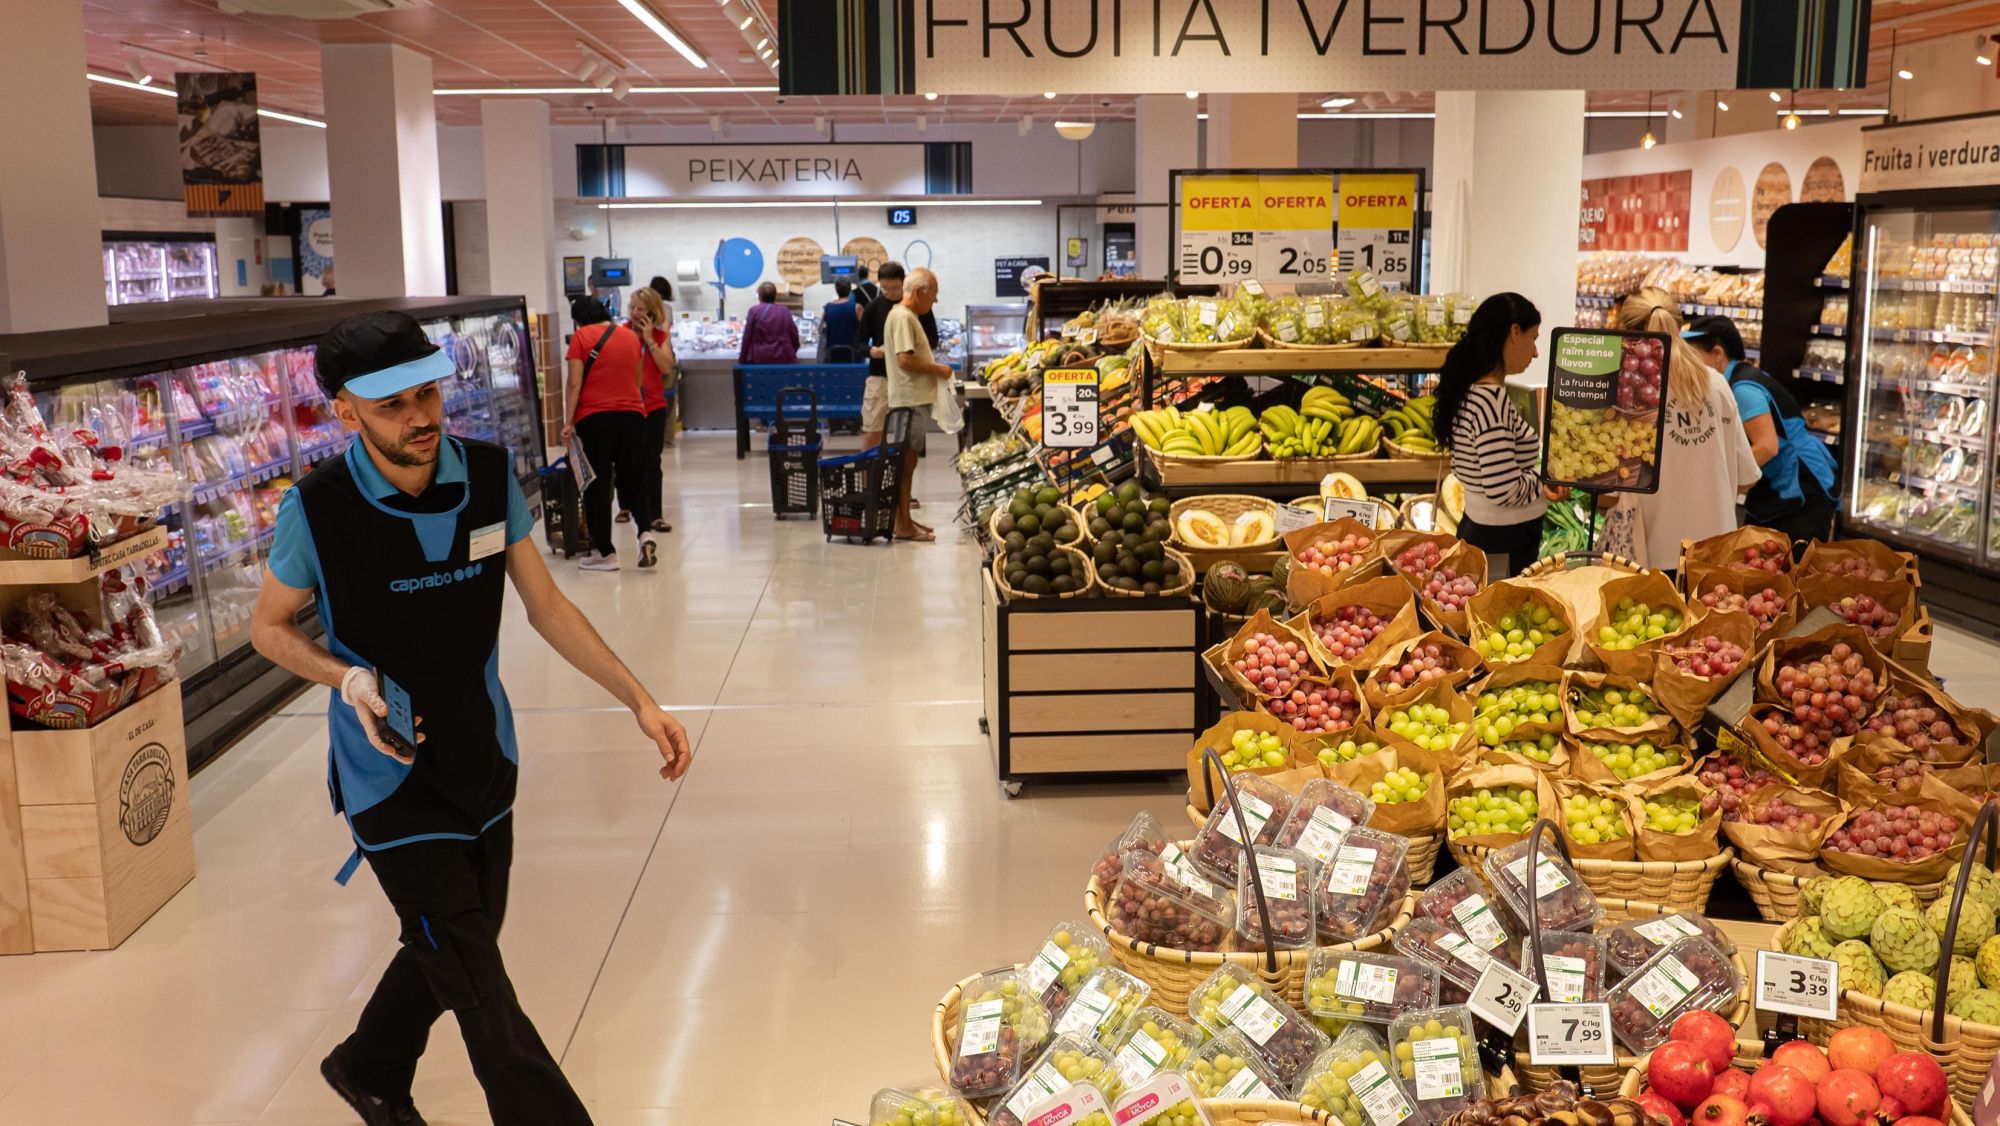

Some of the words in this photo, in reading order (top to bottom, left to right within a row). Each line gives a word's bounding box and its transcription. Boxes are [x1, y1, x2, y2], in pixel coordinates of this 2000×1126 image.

[1295, 0, 1729, 56] VERDURA
[1863, 146, 1912, 173] Fruita
[1918, 144, 1924, 168] i
[1928, 140, 2000, 168] verdura
[688, 158, 863, 184] PEIXATERIA
[1189, 196, 1252, 209] OFERTA
[1264, 196, 1326, 209] OFERTA
[1345, 194, 1408, 208] OFERTA
[893, 210, 910, 223] 05
[1200, 246, 1252, 278] 0,99
[1279, 247, 1327, 276] 2,05
[1361, 244, 1407, 275] 1,85
[1563, 334, 1604, 345] Especial
[1562, 347, 1583, 357] raïm
[1584, 350, 1614, 358] sense
[1561, 358, 1593, 368] llavors
[1048, 372, 1094, 381] OFERTA
[1560, 378, 1570, 386] La
[1571, 378, 1594, 388] fruita
[1595, 380, 1609, 389] del
[1559, 388, 1576, 398] bon
[1577, 390, 1607, 401] temps!
[1051, 412, 1094, 436] 3,99
[1669, 429, 1690, 446] NEW
[1692, 424, 1717, 446] YORK
[112, 549, 126, 562] CASA
[126, 536, 160, 556] TARRADELLAS
[389, 572, 452, 594] caprabo
[141, 719, 155, 732] CASA
[122, 768, 134, 795] CASA
[1789, 970, 1828, 997] 3,39
[1809, 974, 1828, 985] €/kg
[1494, 982, 1522, 1014] 2,90
[1561, 1018, 1602, 1043] 7,99
[1581, 1020, 1600, 1028] €/kg
[1130, 1098, 1156, 1117] MOYCA
[1043, 1109, 1069, 1126] MOYCA
